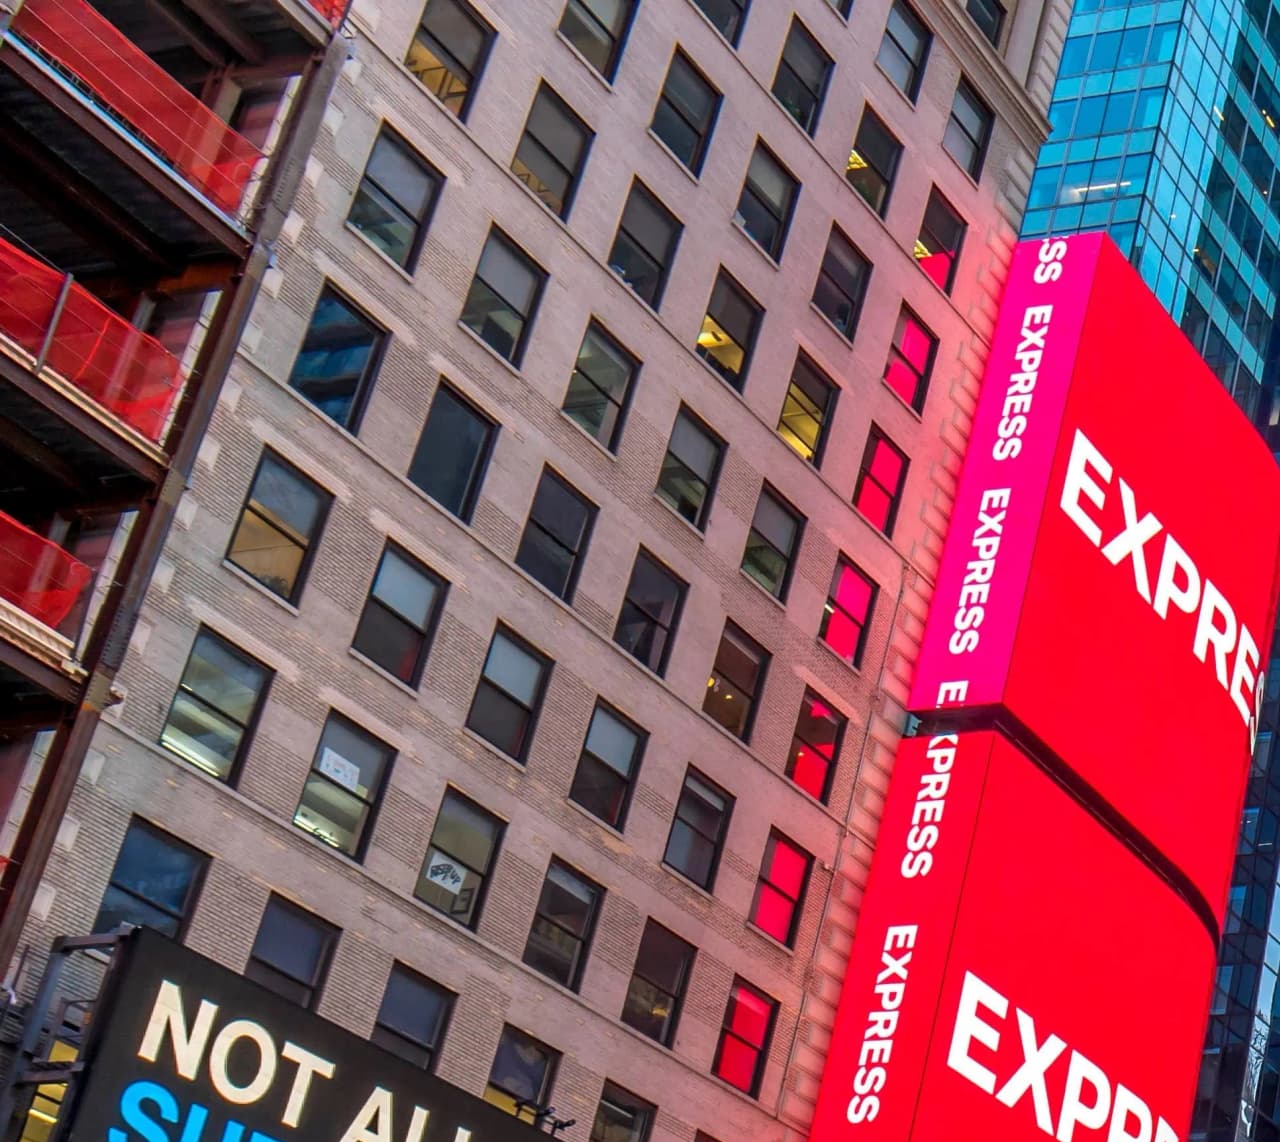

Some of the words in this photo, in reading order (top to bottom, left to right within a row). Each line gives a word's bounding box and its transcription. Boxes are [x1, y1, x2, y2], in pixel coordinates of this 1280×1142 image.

[992, 305, 1053, 461] EXPRESS
[949, 488, 1011, 655] EXPRESS
[138, 979, 334, 1130] NOT
[846, 924, 918, 1124] EXPRESS
